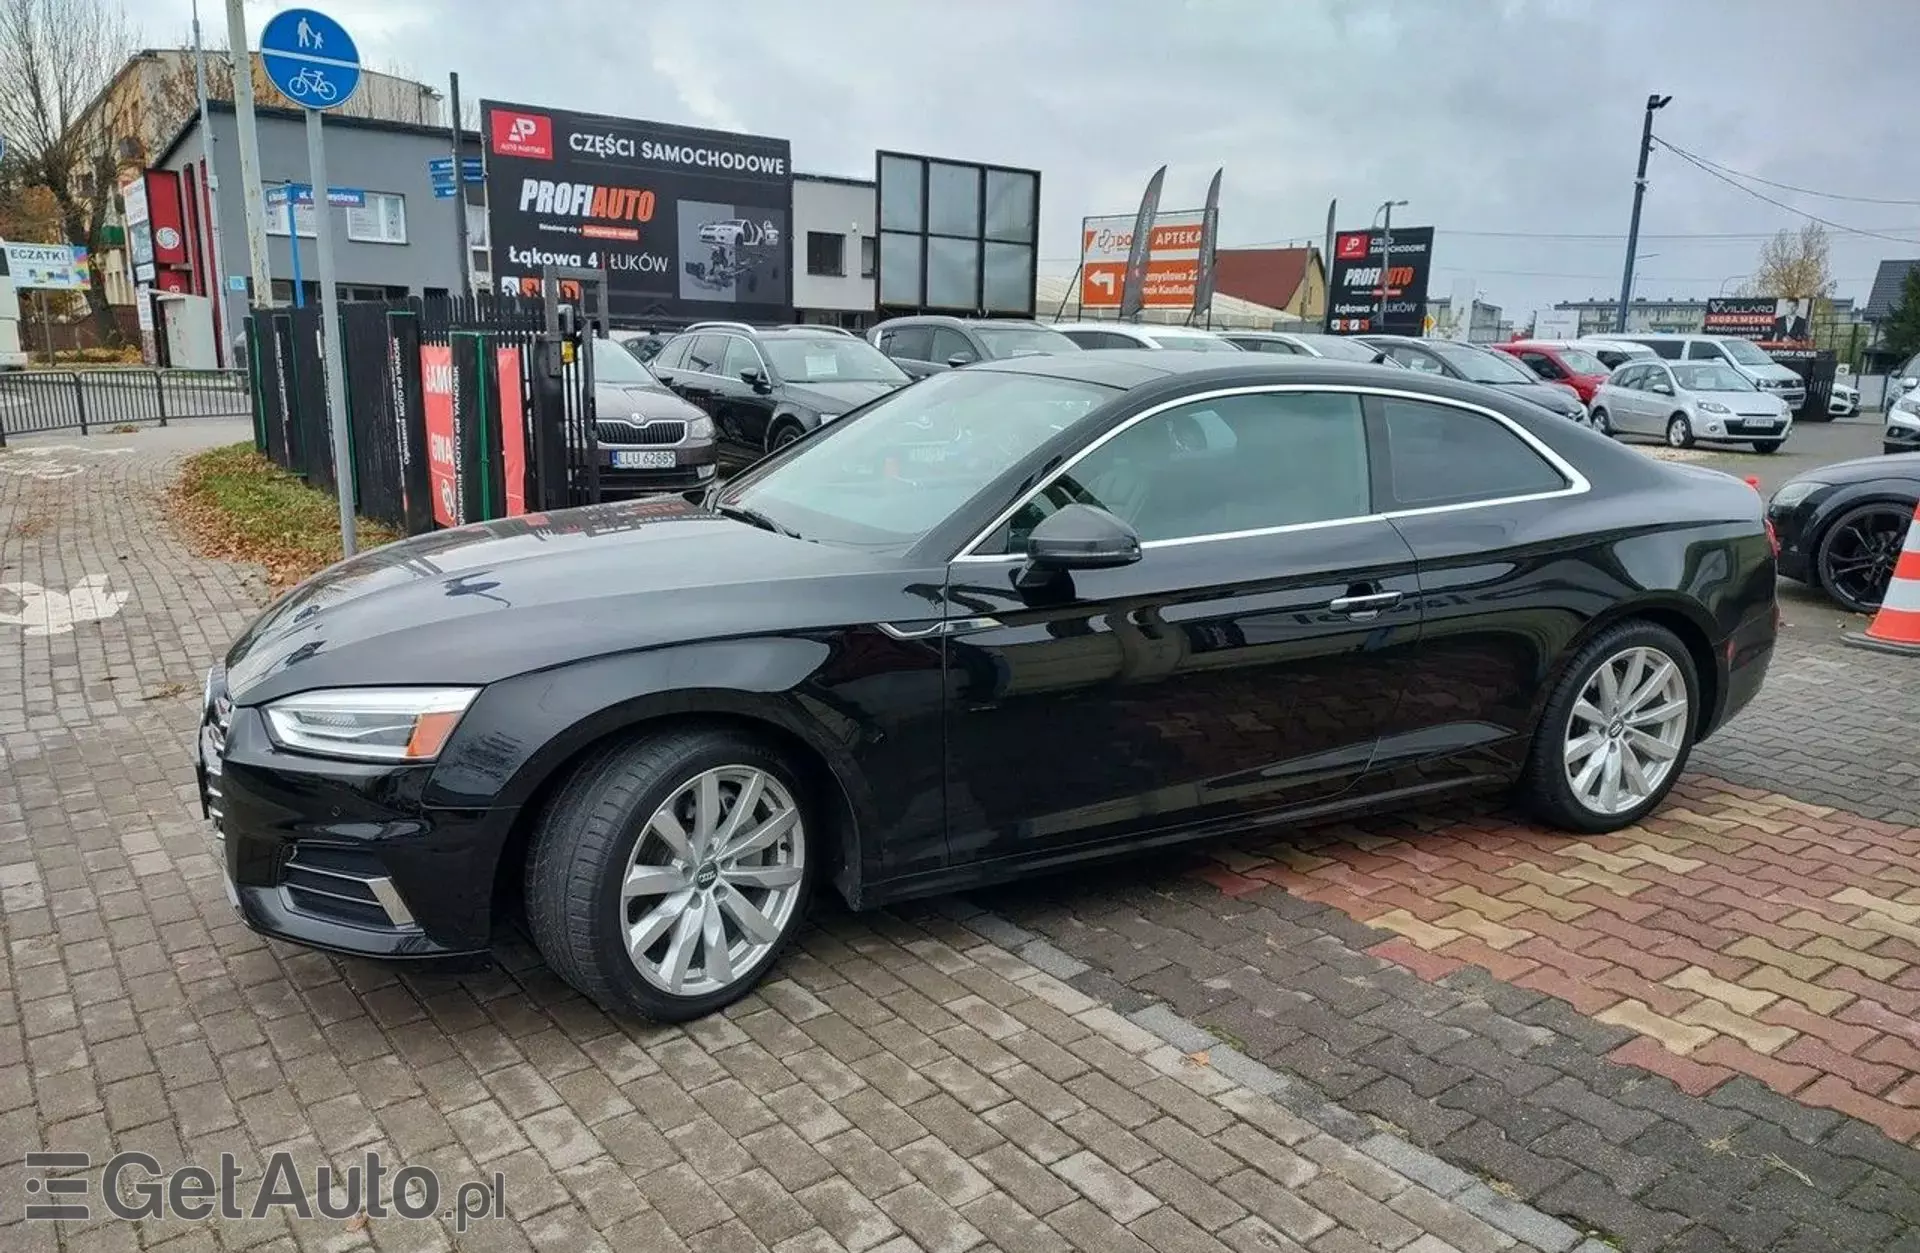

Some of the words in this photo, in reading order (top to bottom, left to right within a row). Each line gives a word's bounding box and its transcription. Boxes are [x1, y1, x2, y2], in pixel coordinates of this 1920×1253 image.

[569, 133, 635, 158] CZĘŚCI
[641, 141, 786, 175] SAMOCHODOWE
[519, 178, 657, 222] PROFIAUTO
[1155, 230, 1202, 246] APTEKA
[1369, 244, 1426, 254] SAMCHODOWE
[508, 245, 582, 268] Łąkowa
[588, 254, 598, 268] 4
[610, 252, 668, 273] ŁUKÓW
[1372, 303, 1379, 312] 4
[397, 390, 406, 417] MOTO
[453, 366, 461, 417] YANOSIK
[454, 419, 461, 434] od
[455, 436, 463, 472] MOTO
[618, 452, 640, 465] LLU
